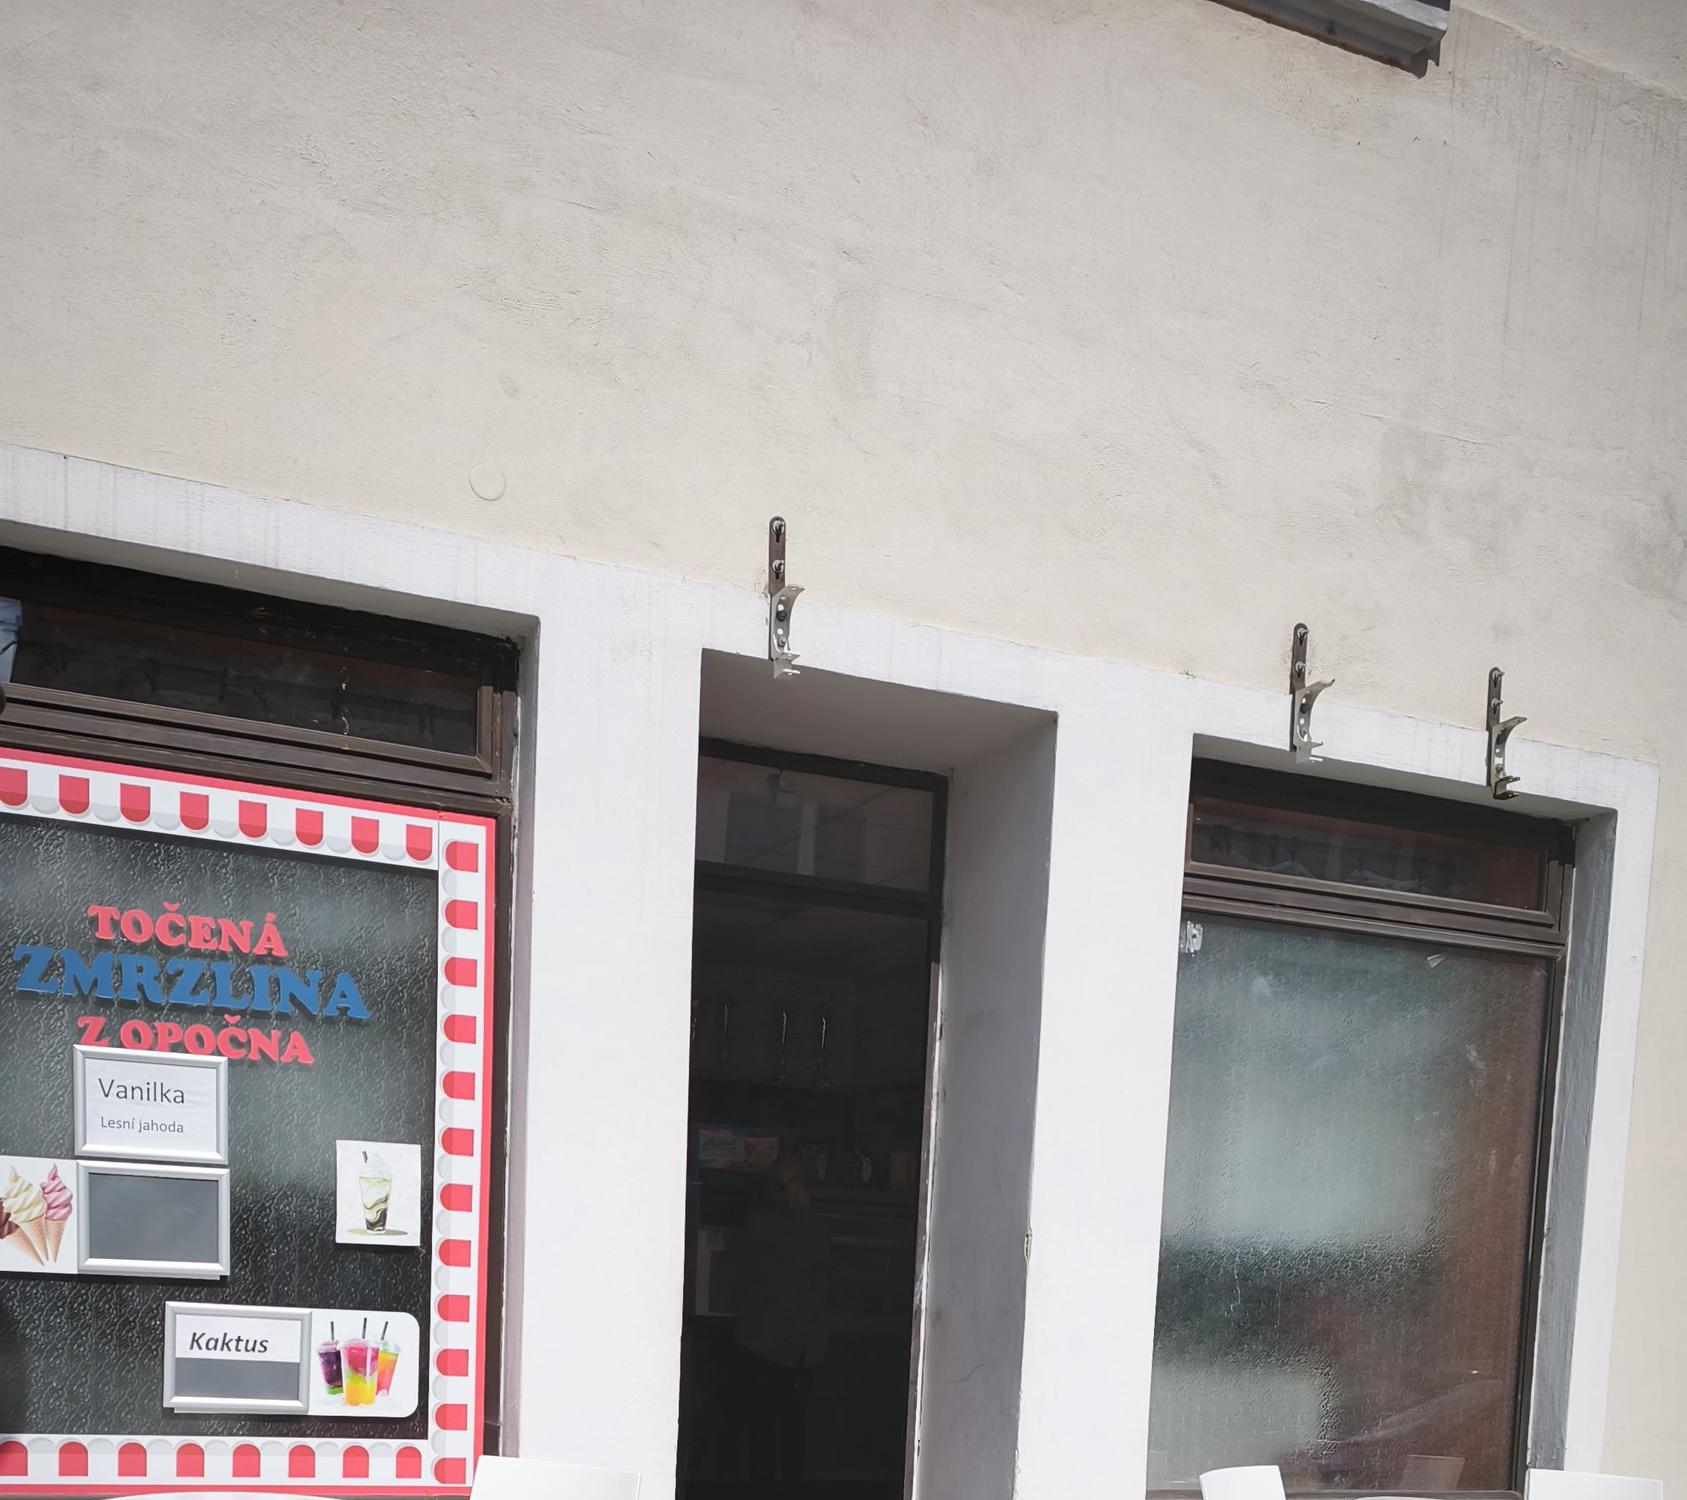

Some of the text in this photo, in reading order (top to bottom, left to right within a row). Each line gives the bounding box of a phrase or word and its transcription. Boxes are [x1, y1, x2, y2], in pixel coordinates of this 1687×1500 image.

[87, 901, 289, 957] TOČENÁ
[13, 944, 370, 1019] ZMRZLINA
[77, 1014, 315, 1064] Z OPOČNA
[98, 1078, 184, 1104] Vanilka
[101, 1116, 184, 1133] Lesní jahoda
[189, 1332, 269, 1353] Kaktus
